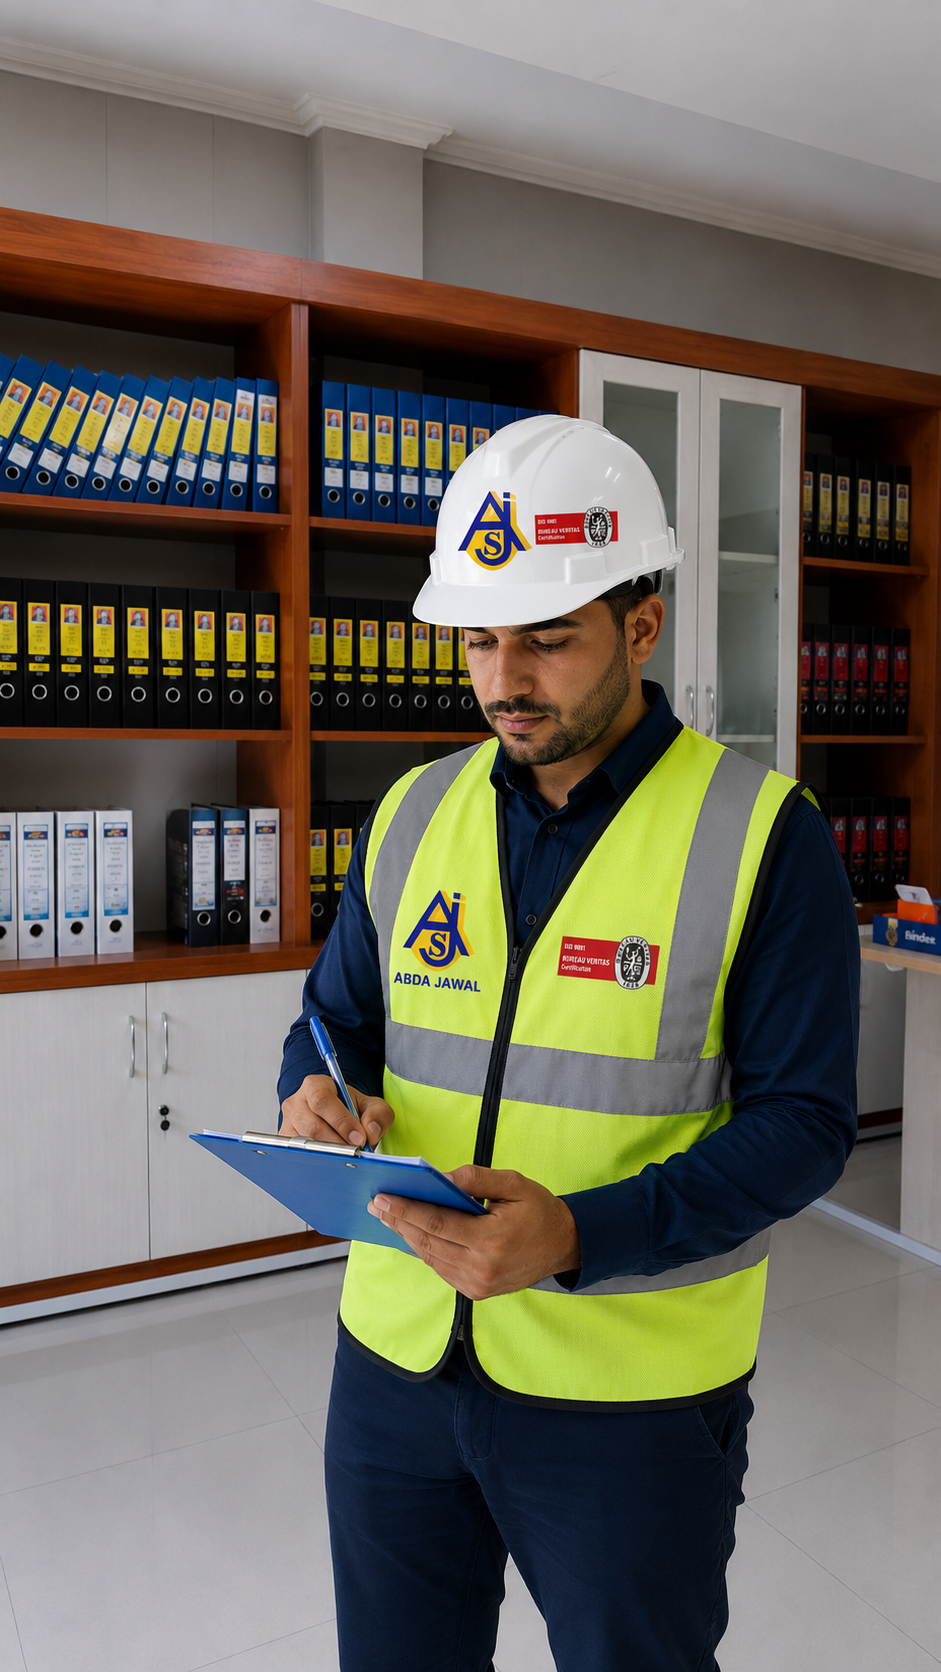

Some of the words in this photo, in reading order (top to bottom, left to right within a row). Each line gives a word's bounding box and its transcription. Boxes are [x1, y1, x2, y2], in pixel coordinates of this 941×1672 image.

[586, 957, 610, 967] VERITAS
[393, 971, 431, 987] ABDA
[434, 976, 481, 993] JAWAL
